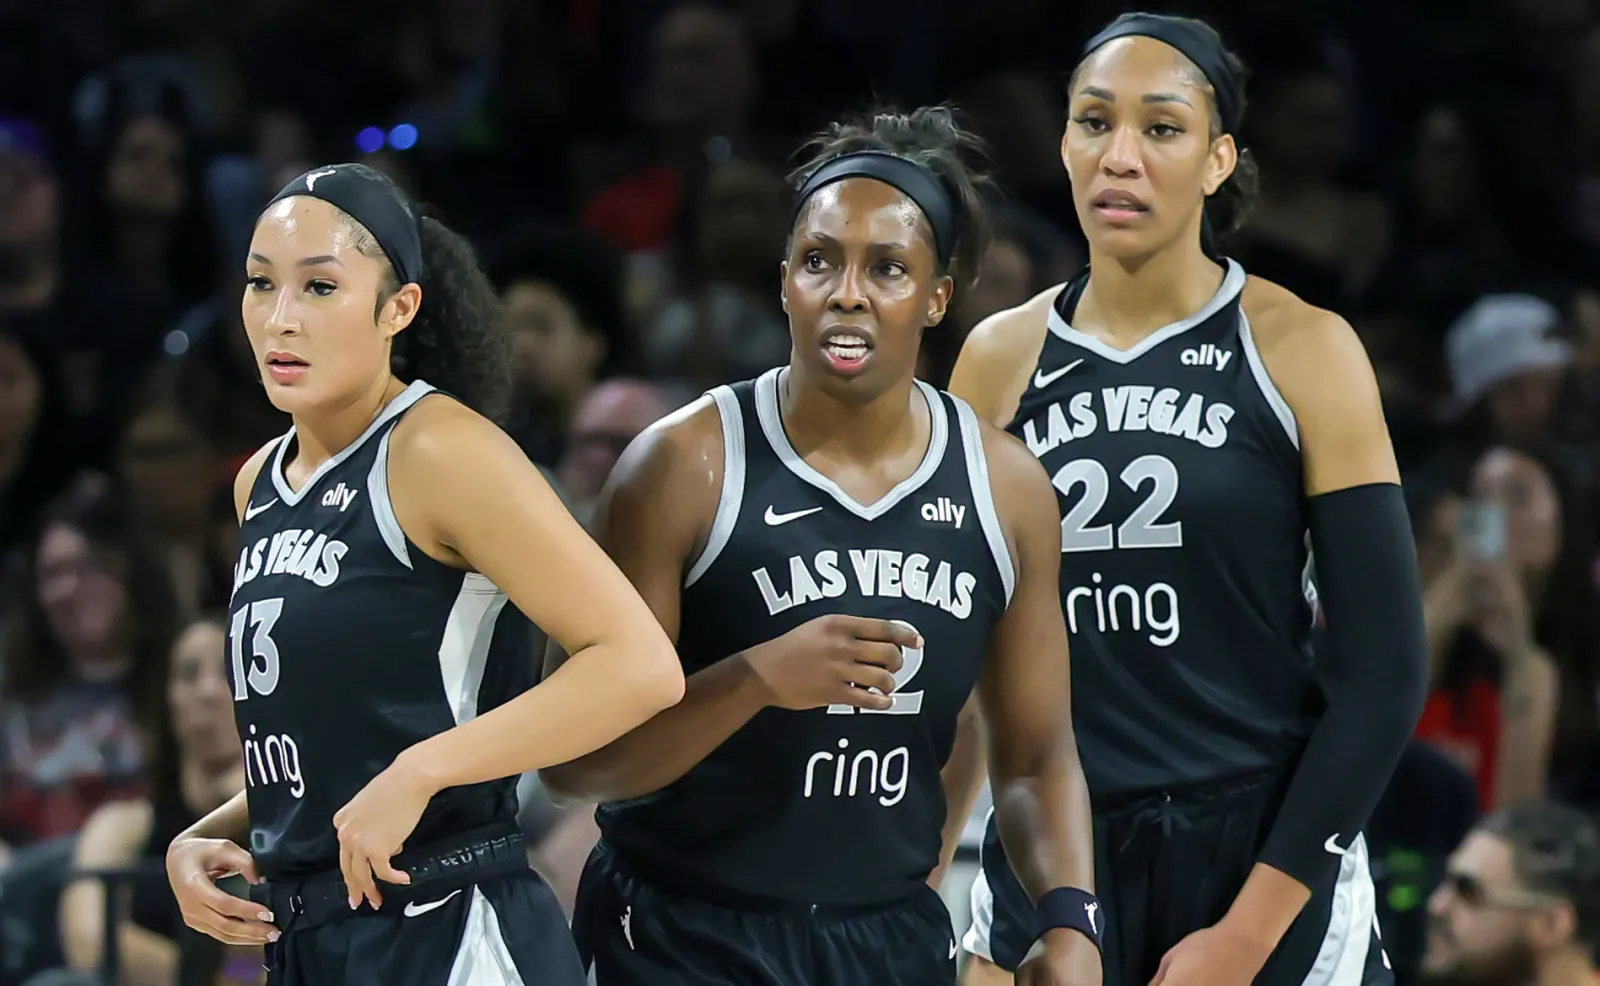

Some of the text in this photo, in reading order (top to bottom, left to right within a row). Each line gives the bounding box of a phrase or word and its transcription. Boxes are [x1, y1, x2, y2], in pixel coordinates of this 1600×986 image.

[1181, 344, 1232, 371] ally
[1023, 385, 1236, 458] LAS VEGAS
[322, 482, 359, 512] ally
[921, 497, 966, 529] ally
[1051, 454, 1183, 552] 22
[263, 529, 349, 587] VEGAS
[752, 549, 977, 620] LAS VEGAS
[1066, 572, 1180, 647] ring
[229, 597, 285, 701] 13
[827, 619, 925, 715] 2
[244, 724, 306, 798] ring
[804, 738, 910, 807] ring
